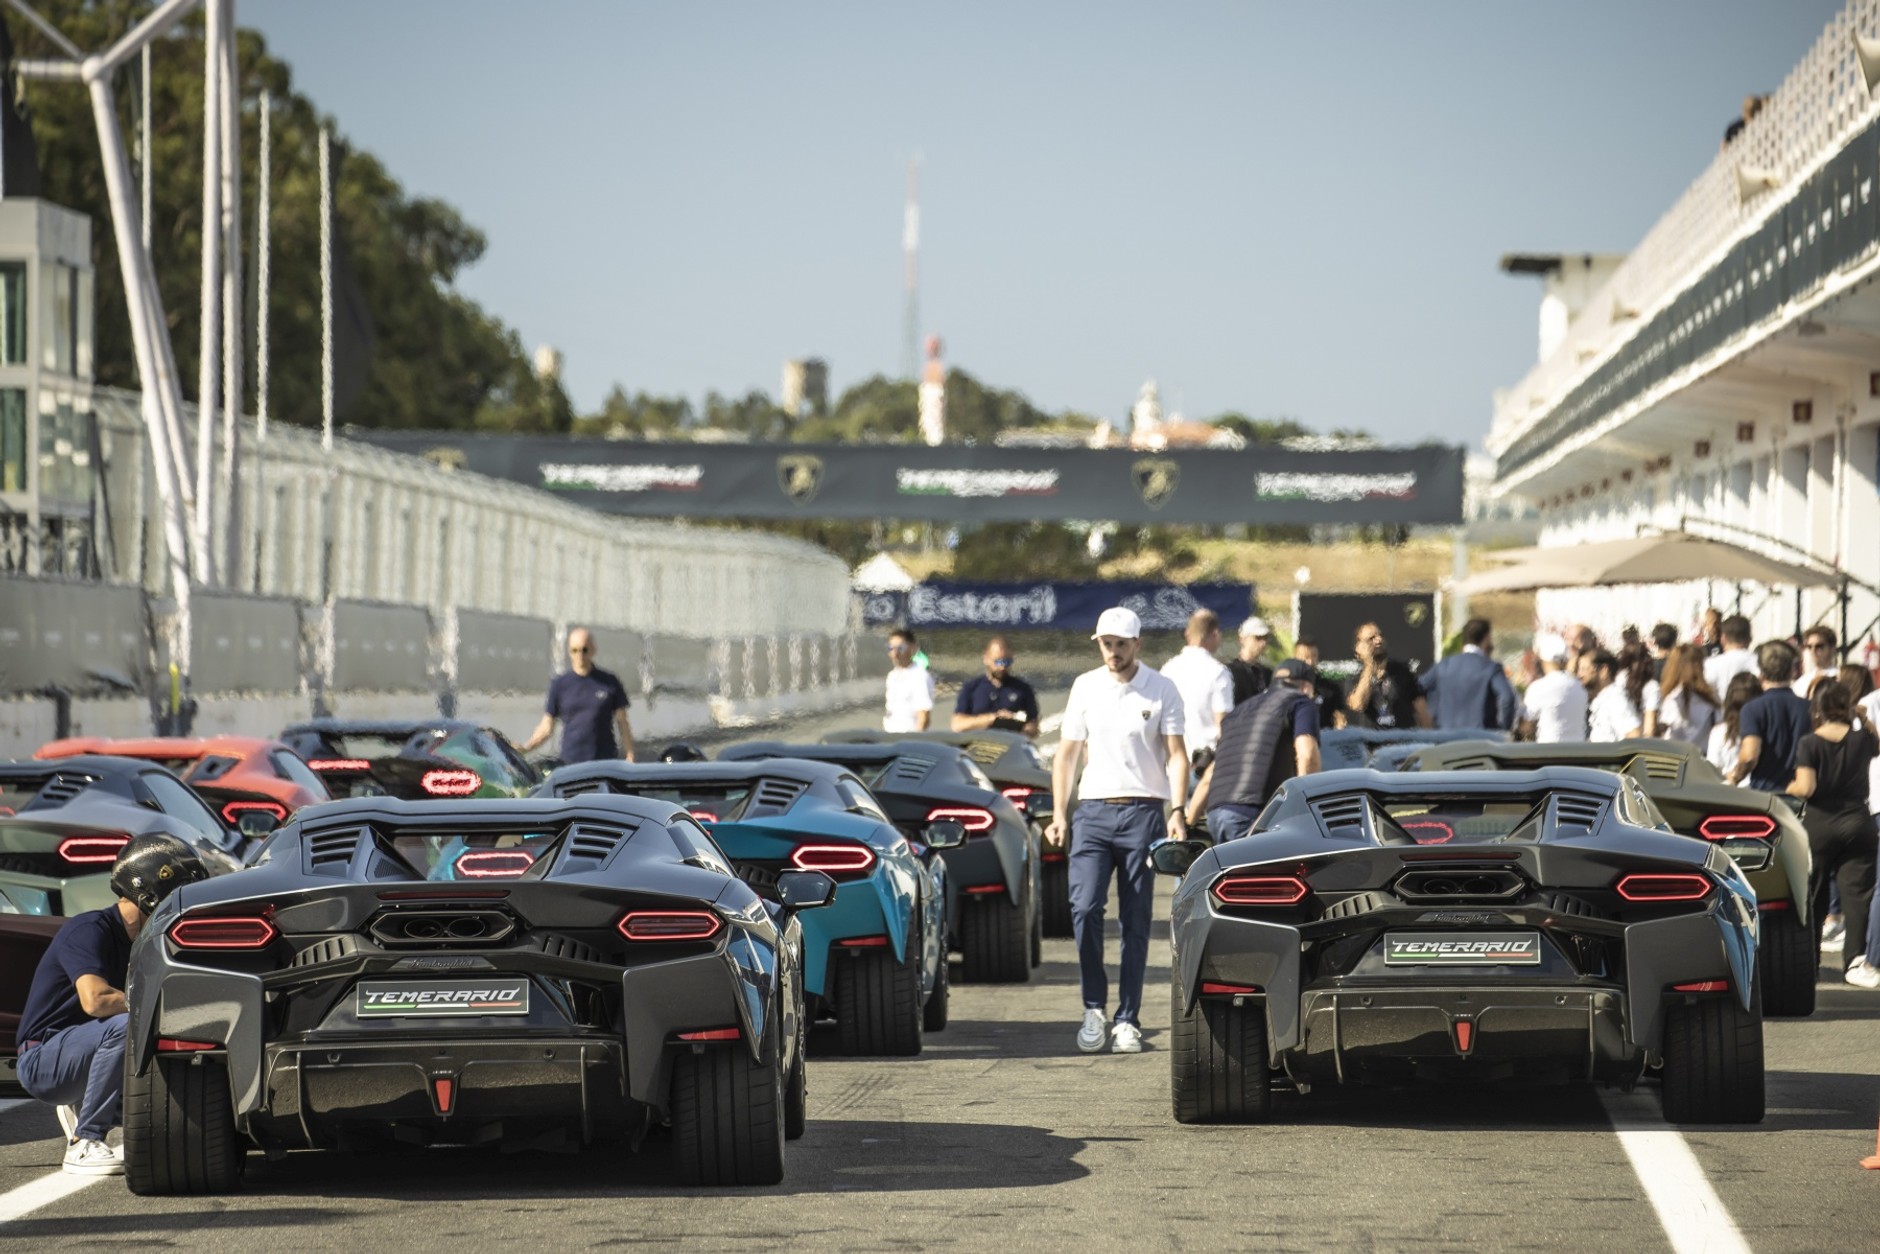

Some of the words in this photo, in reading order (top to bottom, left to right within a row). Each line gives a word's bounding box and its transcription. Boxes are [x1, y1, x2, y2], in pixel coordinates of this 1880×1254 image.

[907, 584, 1057, 625] Estoril
[1392, 939, 1533, 953] TEMERARIO
[365, 987, 520, 1004] TEMERARIO
